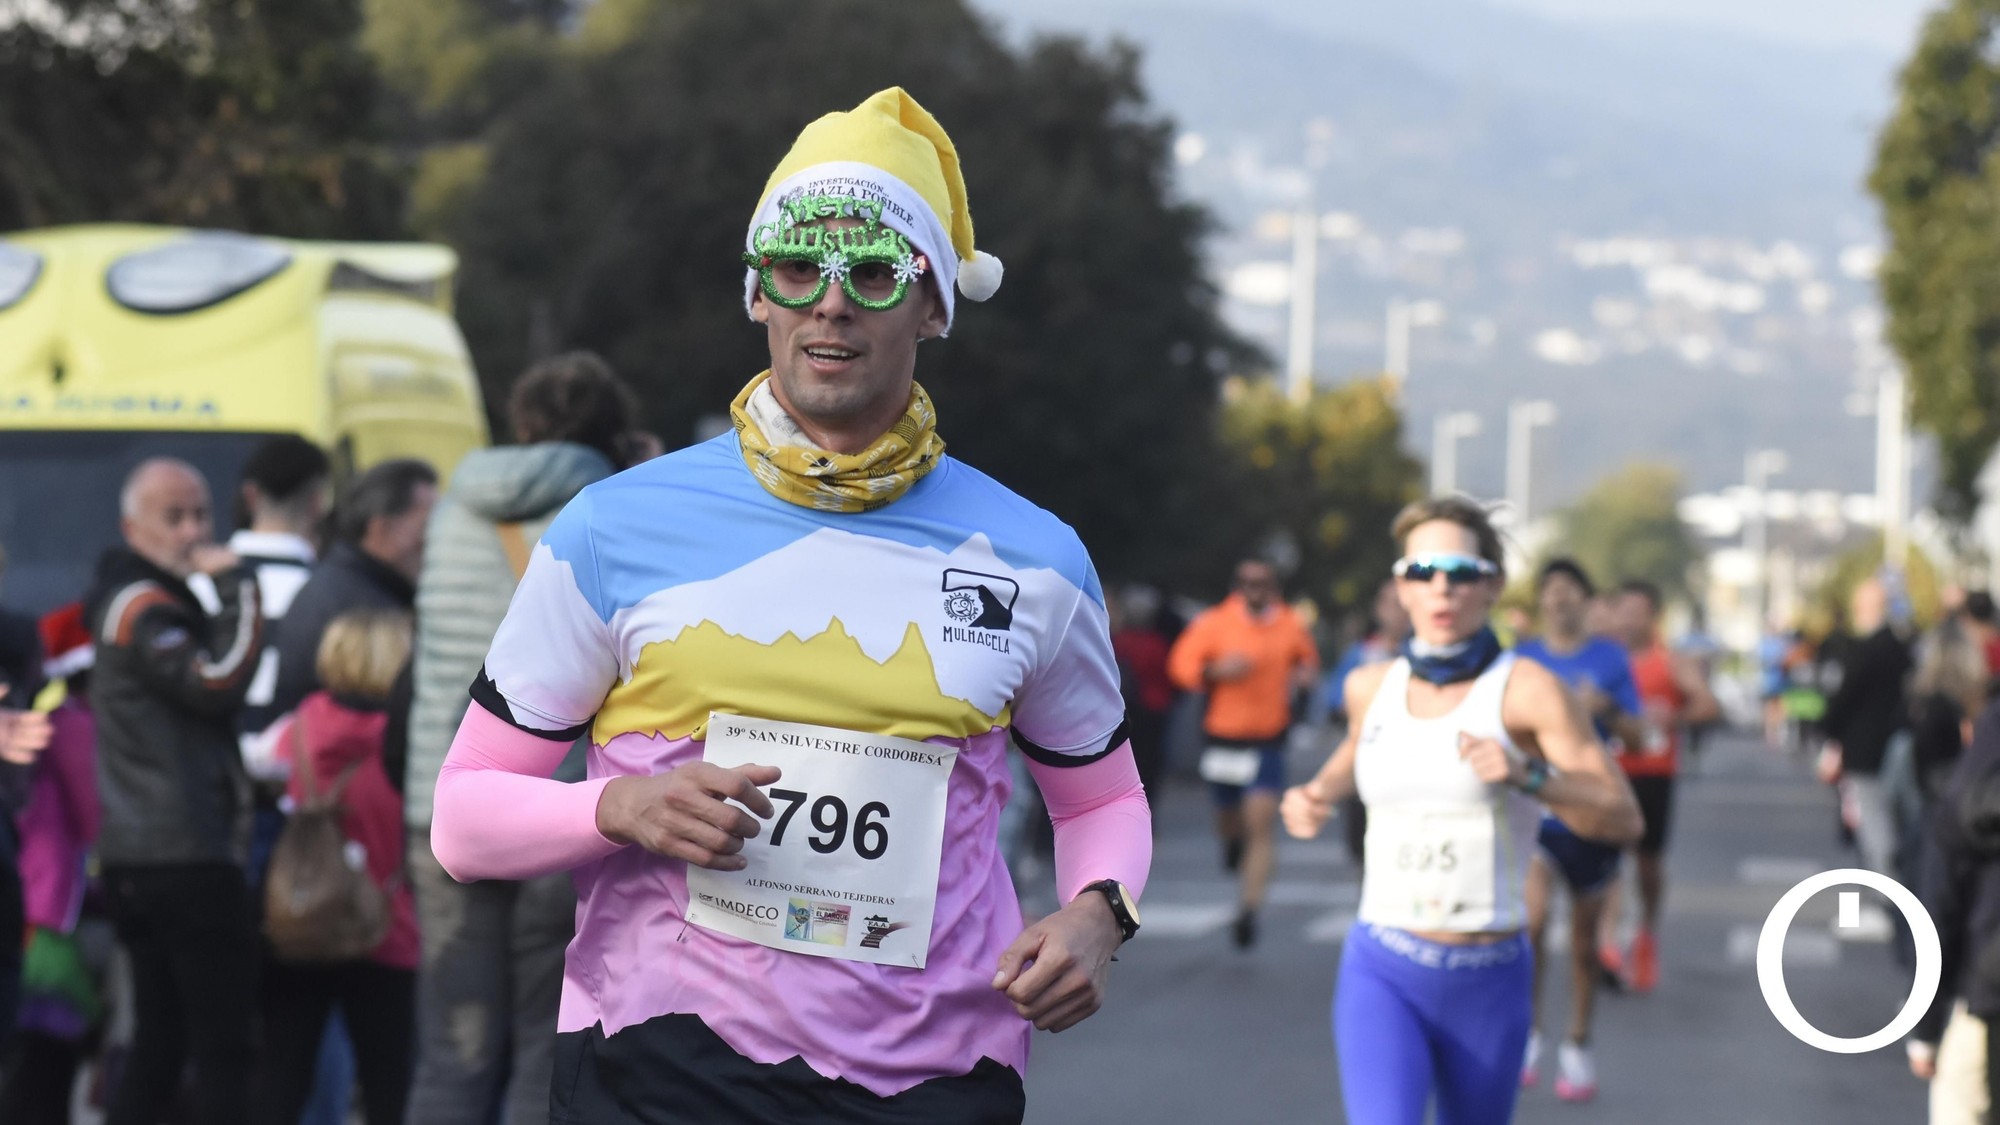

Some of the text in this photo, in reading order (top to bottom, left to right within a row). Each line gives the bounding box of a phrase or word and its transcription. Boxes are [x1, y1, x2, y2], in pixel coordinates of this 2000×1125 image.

[807, 186, 857, 198] HAZLA
[943, 625, 1010, 655] MULHACELA
[748, 729, 778, 743] SAN
[780, 733, 861, 755] SILVESTRE
[864, 745, 943, 767] CORDOBESA
[769, 787, 891, 860] 796
[745, 878, 896, 906] ALFONSO SERRANO TEJEDERAS
[715, 897, 779, 920] IMDECO
